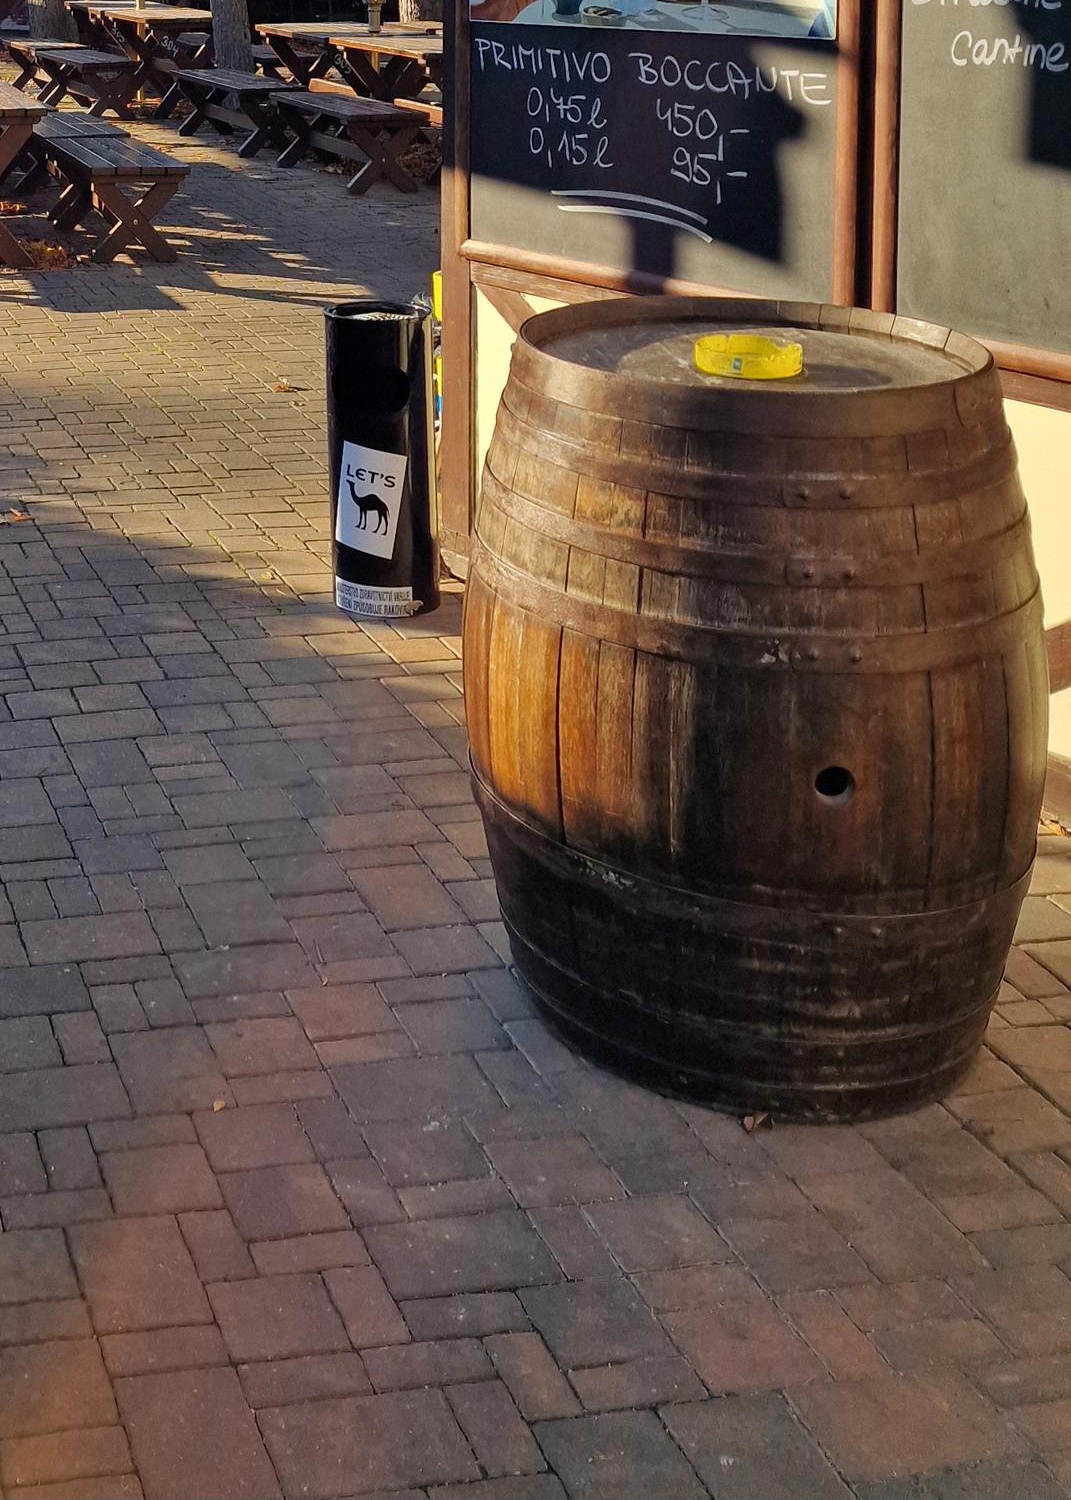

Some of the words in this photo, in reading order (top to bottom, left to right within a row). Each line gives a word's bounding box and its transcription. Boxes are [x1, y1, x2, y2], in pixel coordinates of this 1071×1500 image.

[475, 38, 611, 83] PRIMITIVO
[628, 52, 833, 106] BOCCANTE
[346, 463, 396, 488] LET'S
